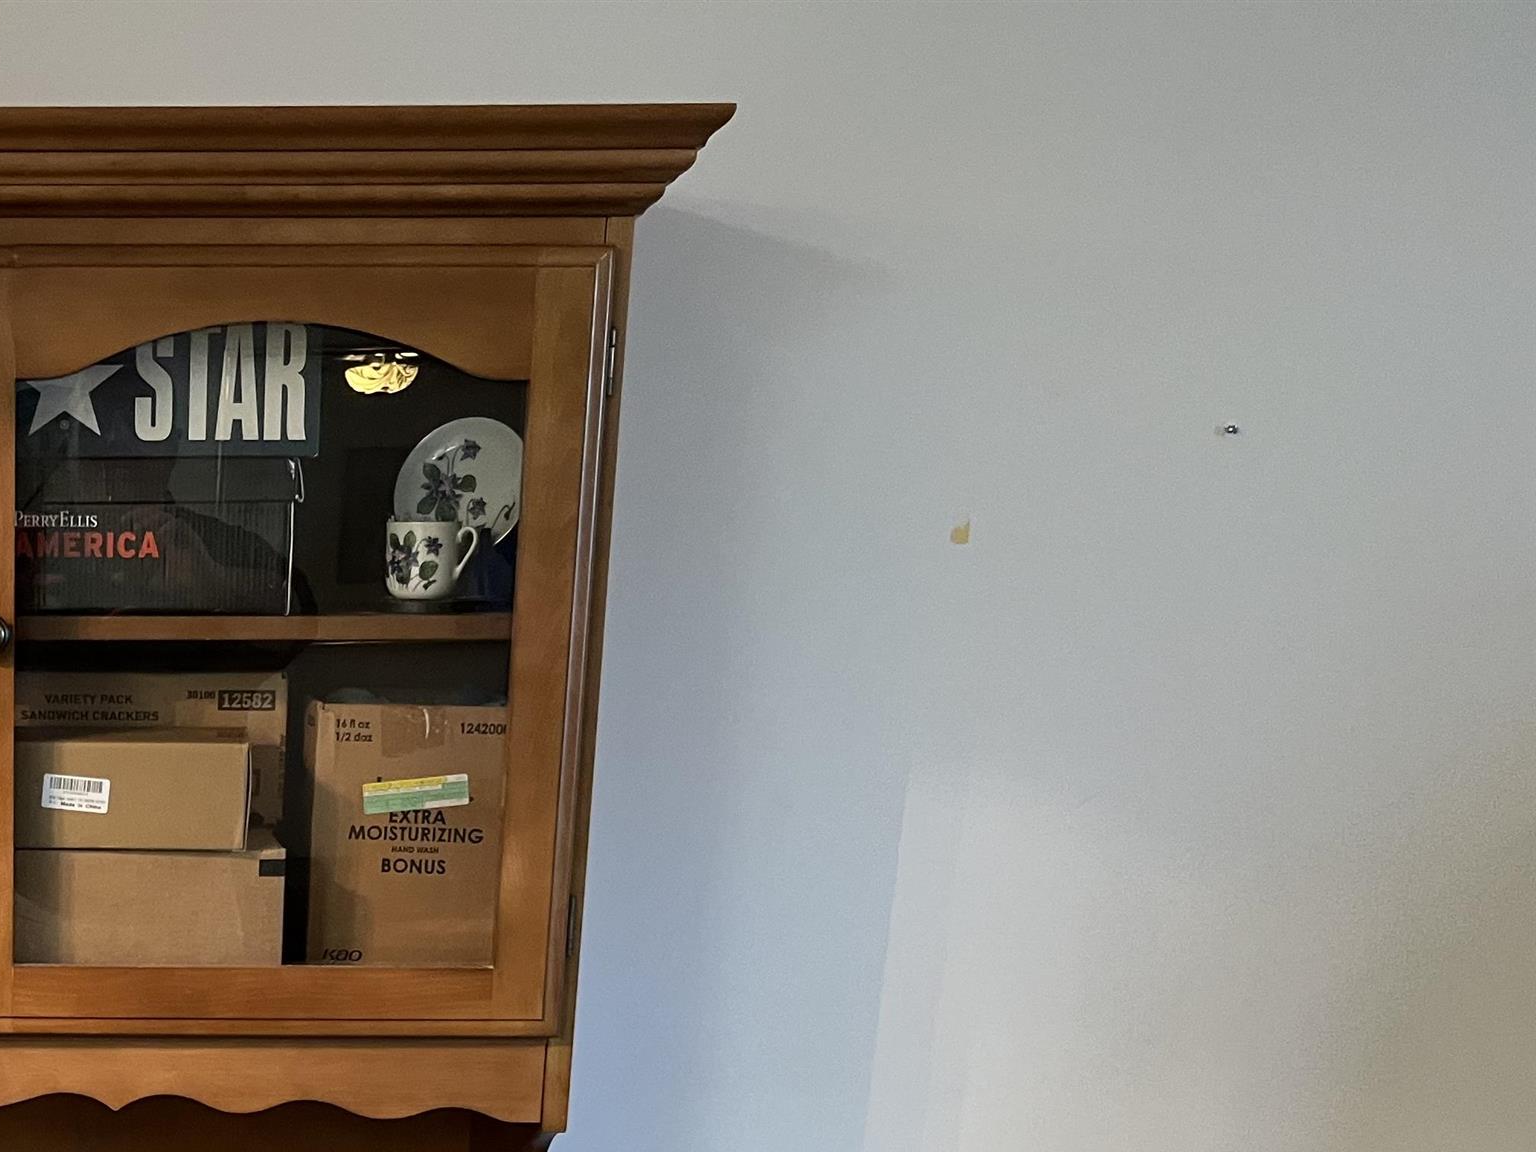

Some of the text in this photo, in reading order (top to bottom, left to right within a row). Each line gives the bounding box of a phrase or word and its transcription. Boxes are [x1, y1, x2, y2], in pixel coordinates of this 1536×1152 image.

[134, 322, 307, 442] STAR
[16, 530, 160, 559] AMERICA
[44, 693, 134, 705] VARIETY PACK
[221, 692, 273, 708] 12582
[20, 710, 160, 721] SANDWICH CRACKERS
[336, 719, 347, 729] 16
[336, 732, 373, 743] 1/2 doz
[388, 810, 446, 825] EXTRA
[348, 825, 484, 844] MOISTURIZING
[381, 858, 446, 875] BONUS
